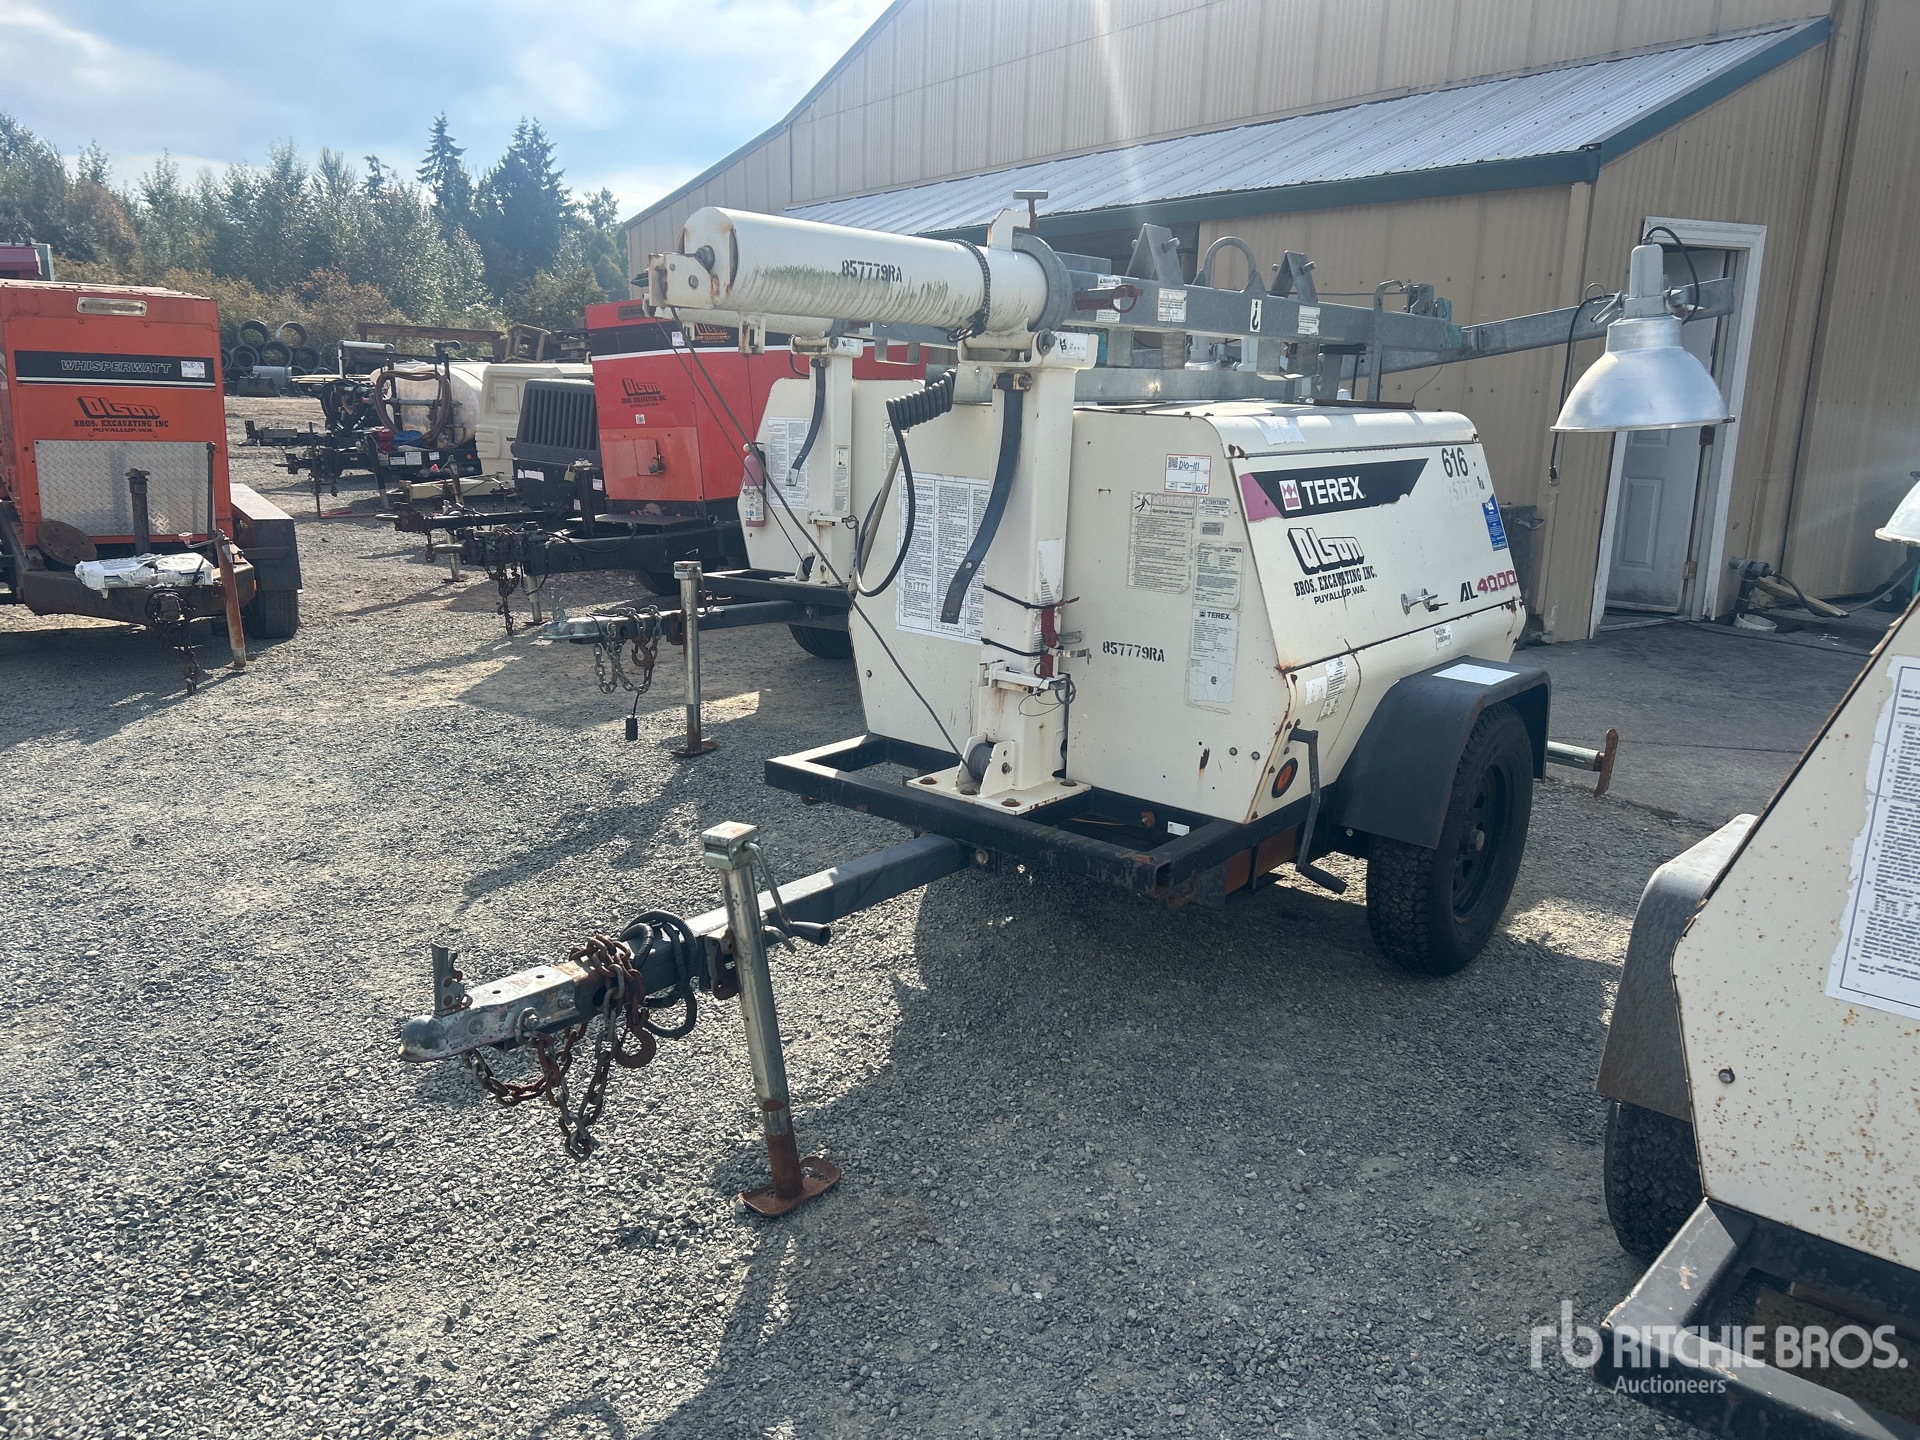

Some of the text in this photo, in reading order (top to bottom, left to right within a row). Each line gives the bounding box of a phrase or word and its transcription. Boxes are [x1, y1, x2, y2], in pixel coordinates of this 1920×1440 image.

[841, 259, 903, 283] 857779RA
[61, 359, 172, 374] WHISPERWATT
[621, 377, 661, 396] Olson
[77, 395, 161, 419] Olson
[74, 419, 98, 428] BROS.
[101, 419, 152, 428] EXCAVATING
[1441, 447, 1469, 479] 616
[1300, 475, 1364, 506] TEREX
[1286, 527, 1365, 576] Olson
[1294, 565, 1378, 597] BROS. EXCAVATING INC.
[1207, 611, 1231, 621] TEREX
[1102, 640, 1165, 663] 857779RA
